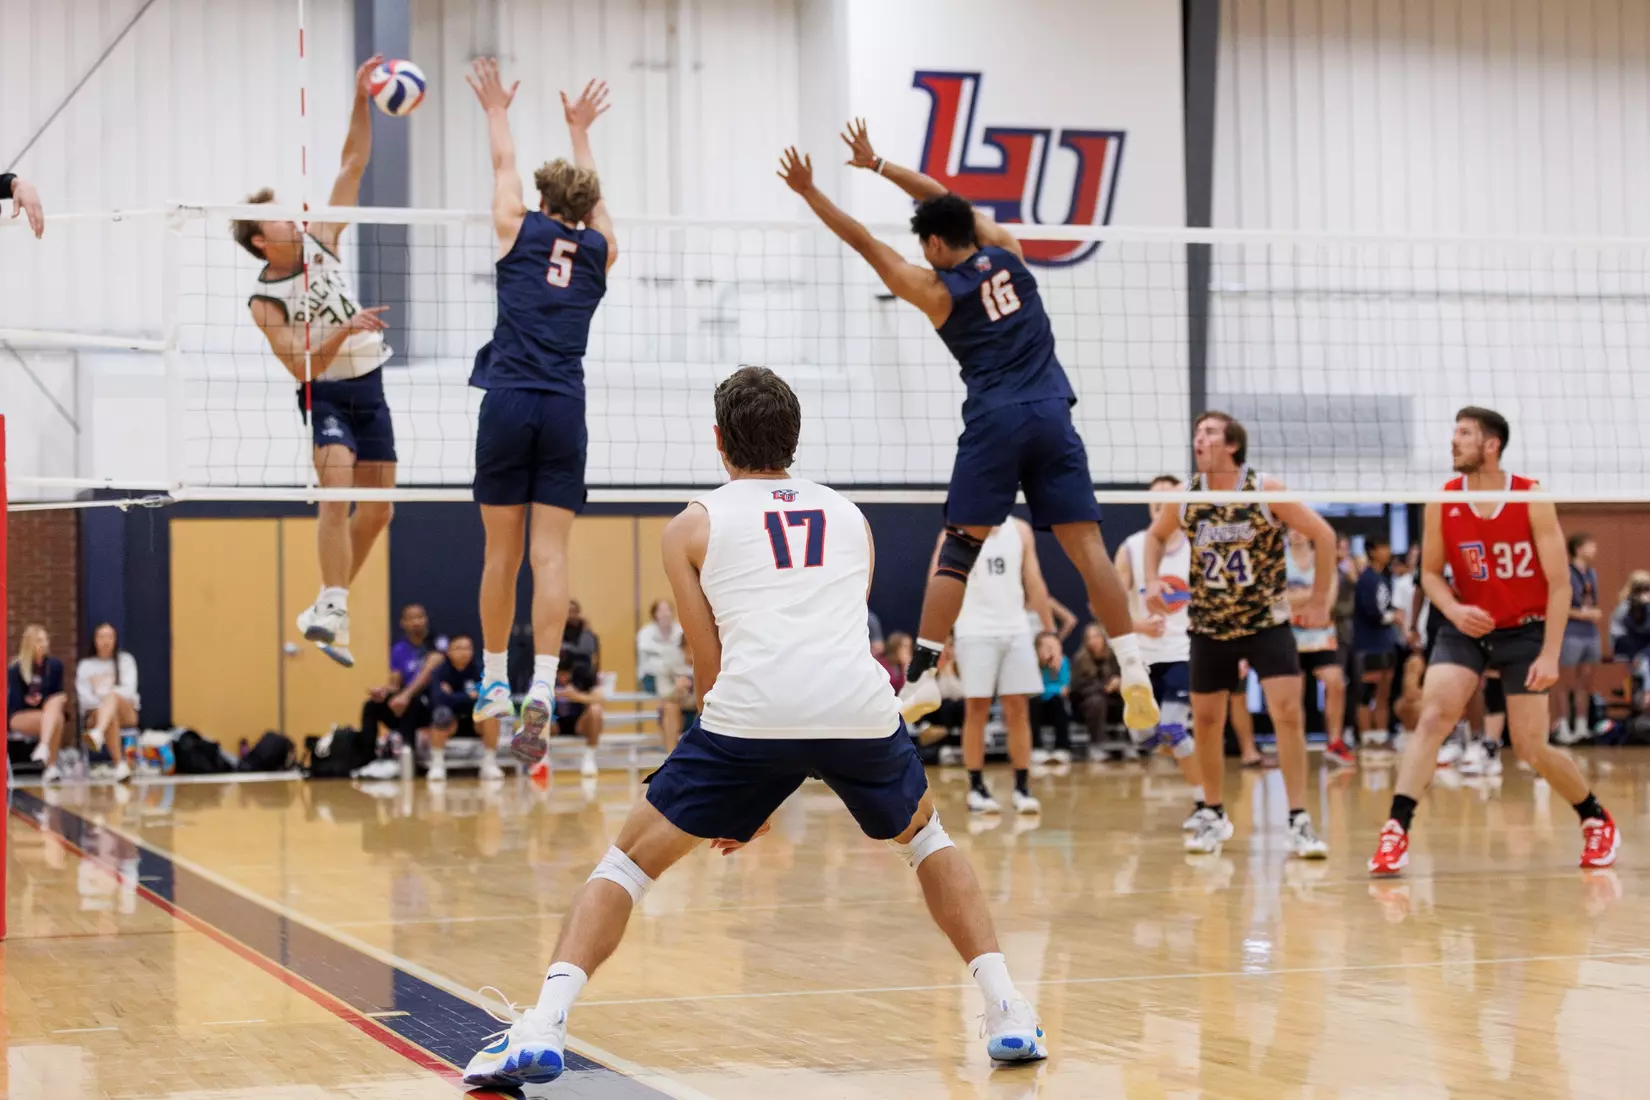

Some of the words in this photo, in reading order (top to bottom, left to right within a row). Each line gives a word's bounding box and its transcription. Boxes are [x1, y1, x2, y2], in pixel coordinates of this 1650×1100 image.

[911, 70, 1127, 268] LU
[546, 237, 578, 289] 5
[981, 268, 1021, 322] 16
[763, 508, 827, 570] 17
[1491, 541, 1535, 579] 32
[986, 556, 1006, 575] 19
[1199, 547, 1254, 588] 24
